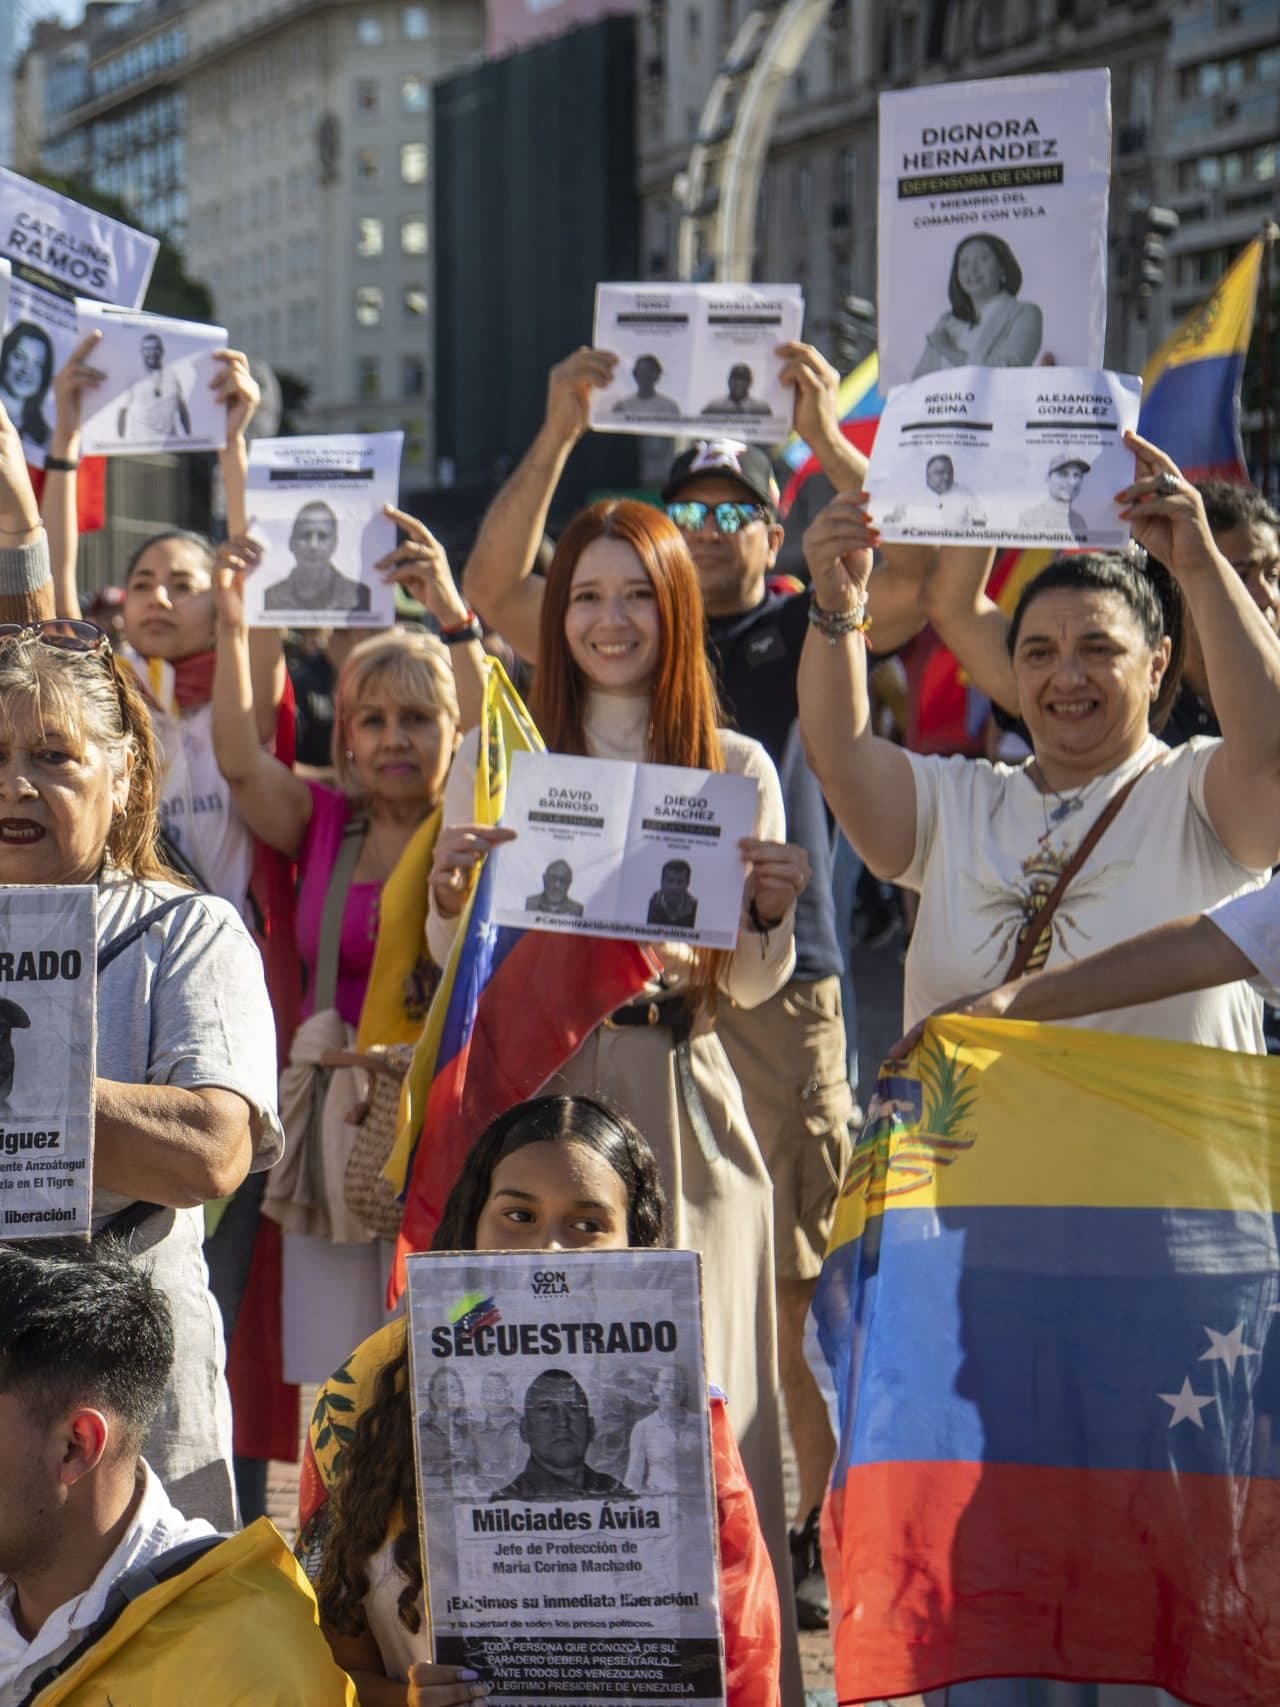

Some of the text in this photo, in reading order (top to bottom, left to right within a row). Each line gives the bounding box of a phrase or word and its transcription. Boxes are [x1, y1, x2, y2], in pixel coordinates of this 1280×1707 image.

[921, 117, 1040, 147] DIGNORA
[902, 139, 1058, 171] HERNÁNDEZ
[902, 167, 1059, 194] DEFENSORA DE DDHH
[940, 195, 999, 209] MIEMBRO
[1002, 193, 1026, 204] DEL
[914, 206, 1046, 228] COMANDO CON VZLA
[7, 228, 107, 288] RAMOS
[1036, 393, 1113, 405] ALEJANDRO
[548, 787, 592, 801] DAVID
[664, 794, 708, 808] DIEGO
[17, 1180, 30, 1189] en
[34, 1178, 43, 1188] El
[46, 1177, 74, 1189] Tigre
[5, 1207, 76, 1224] liberación!
[533, 1272, 566, 1283] CON
[531, 1283, 570, 1294] VZLA
[431, 1320, 677, 1358] SECUESTRADO
[472, 1502, 661, 1532] Milciades Ávila
[495, 1541, 637, 1556] Jefe de Protección de
[534, 1559, 642, 1573] Corina Machado
[521, 1598, 539, 1609] su
[543, 1595, 616, 1608] inmediata
[510, 1620, 522, 1628] de
[555, 1619, 571, 1627] los
[573, 1620, 607, 1629] presos
[483, 1642, 675, 1653] TODA PERSONA QUE CONOZCA DE SU
[488, 1655, 669, 1666] PARADERO PRESENTARLO
[493, 1669, 663, 1680] ANTE TODOS LOS VENEZOLANOS
[547, 1682, 614, 1692] PRESIDENTE
[615, 1682, 630, 1692] DE
[631, 1682, 695, 1693] VENEZUELA
